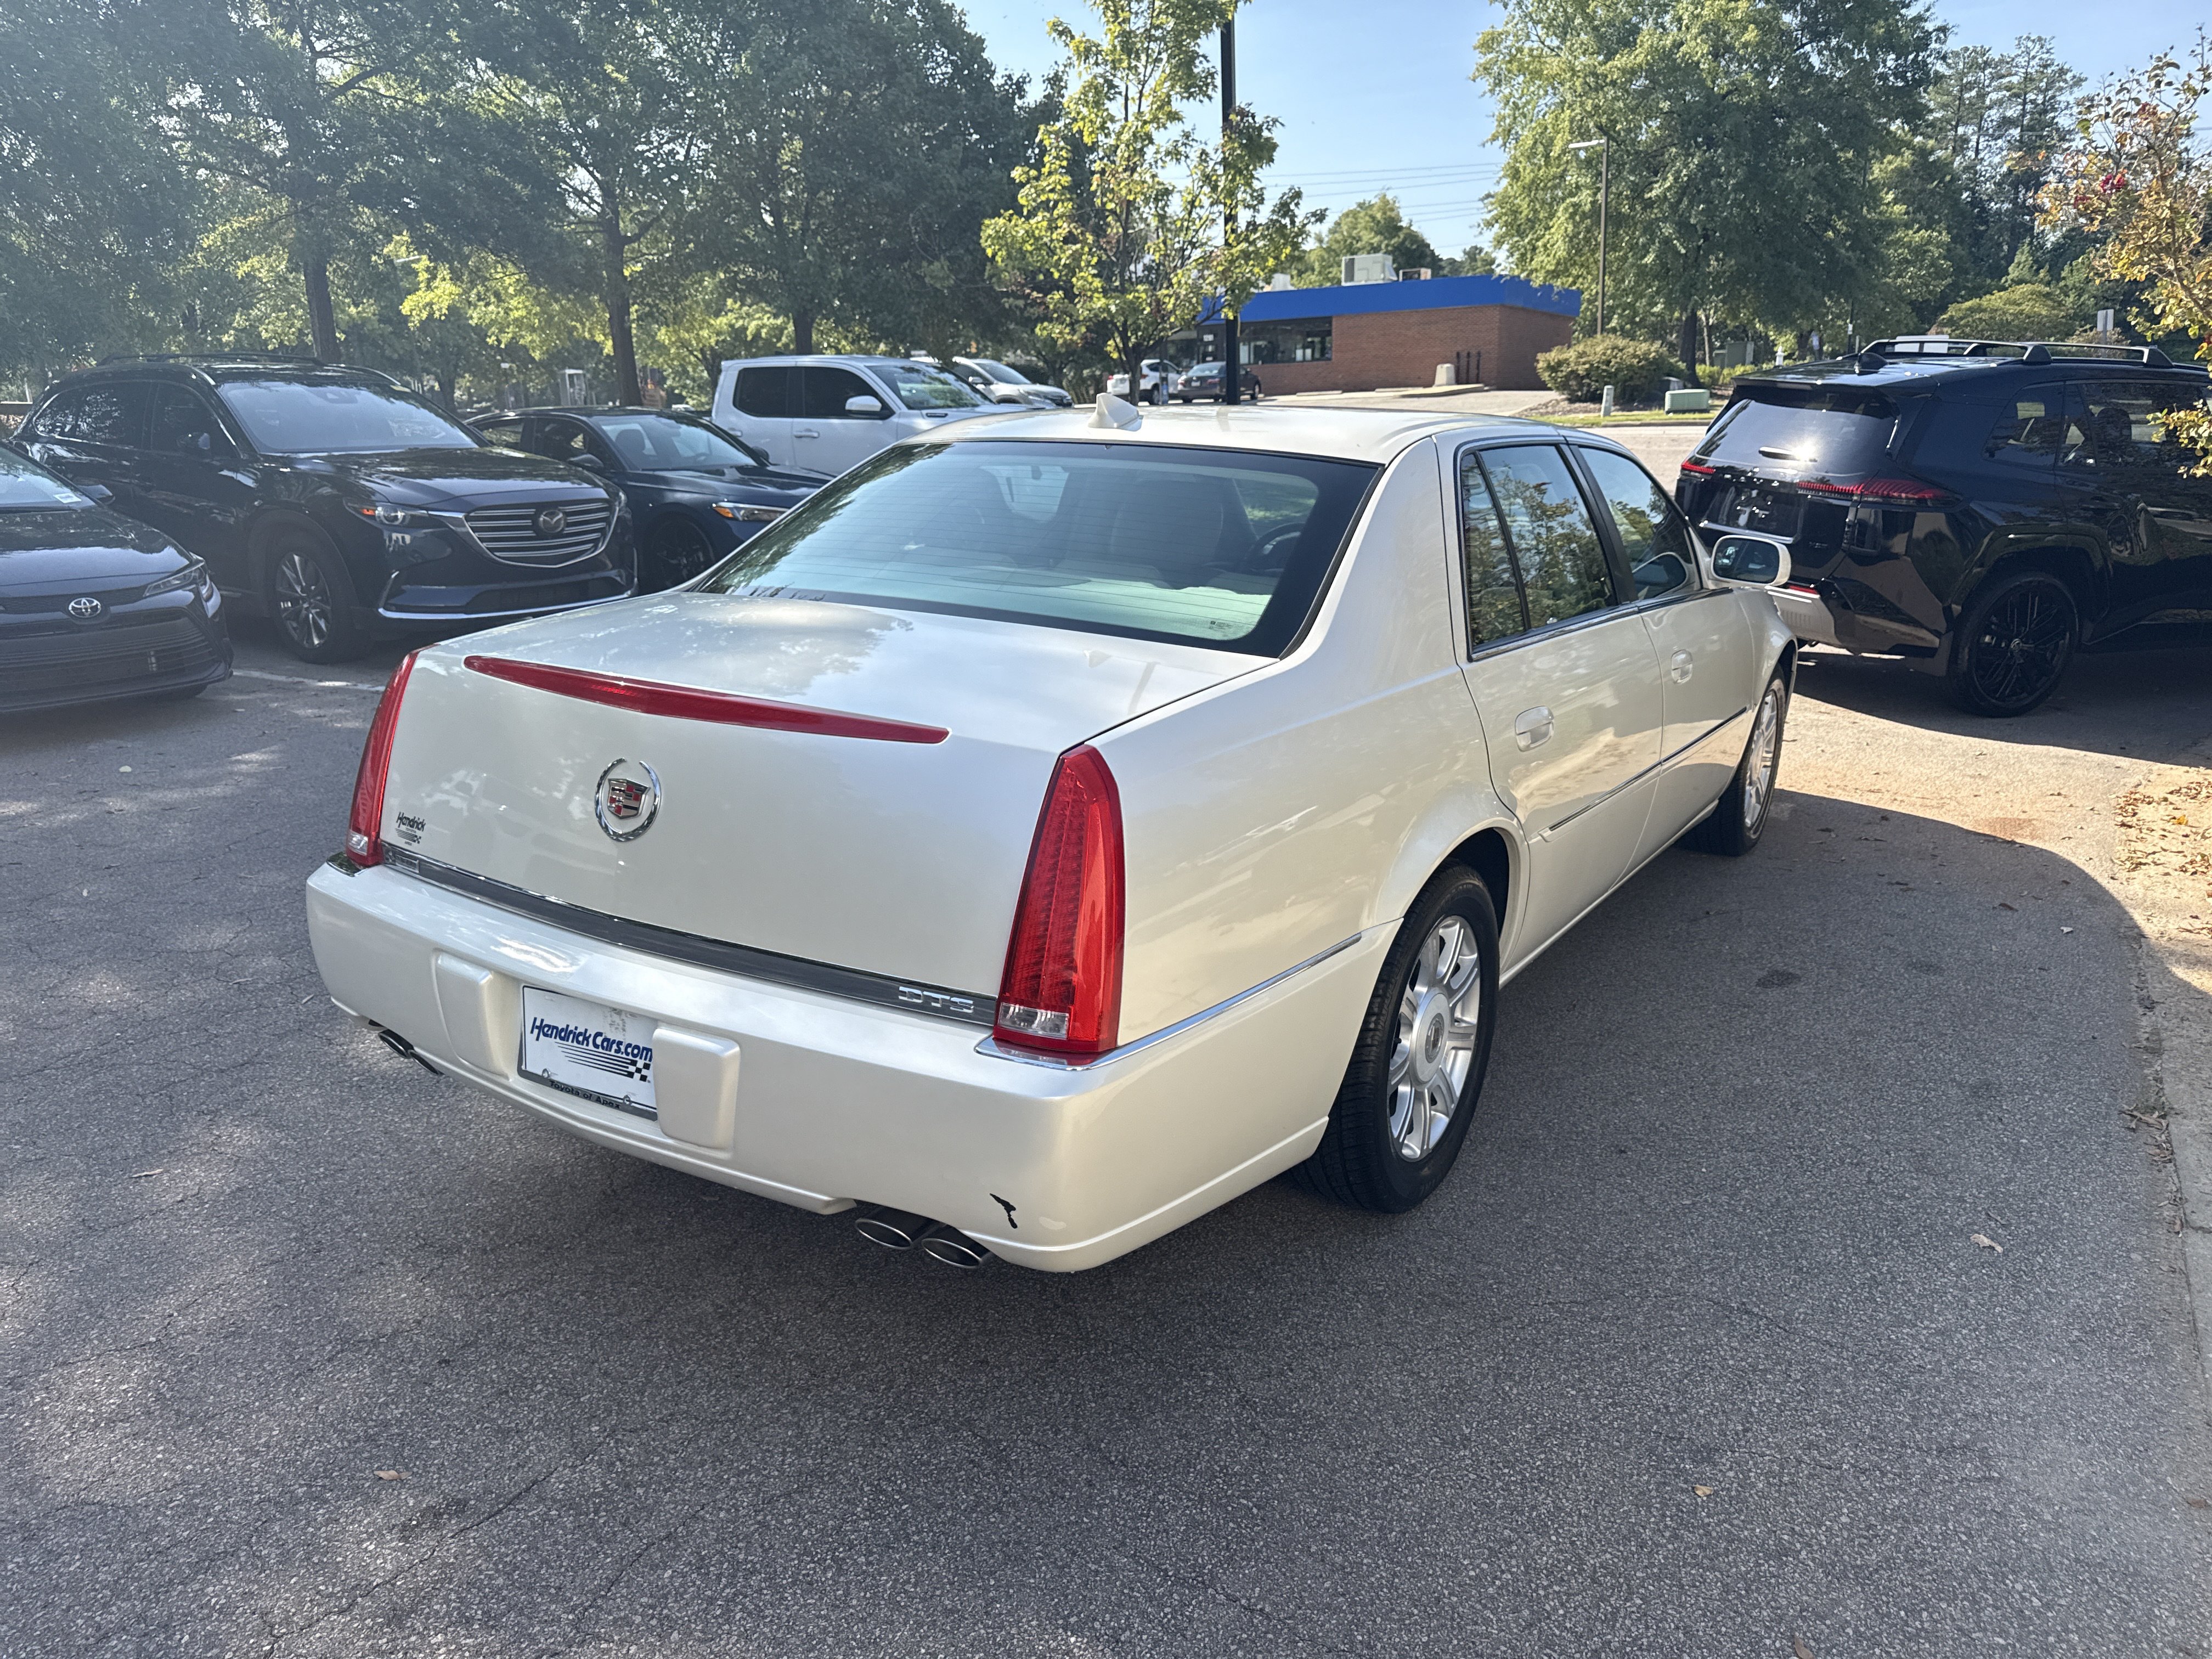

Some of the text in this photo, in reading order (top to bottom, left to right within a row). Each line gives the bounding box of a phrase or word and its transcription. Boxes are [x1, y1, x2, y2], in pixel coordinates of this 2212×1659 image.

[396, 812, 426, 832] Hendrick
[898, 986, 974, 1013] DTS
[549, 1080, 580, 1096] Toyota
[595, 1096, 620, 1109] Apex
